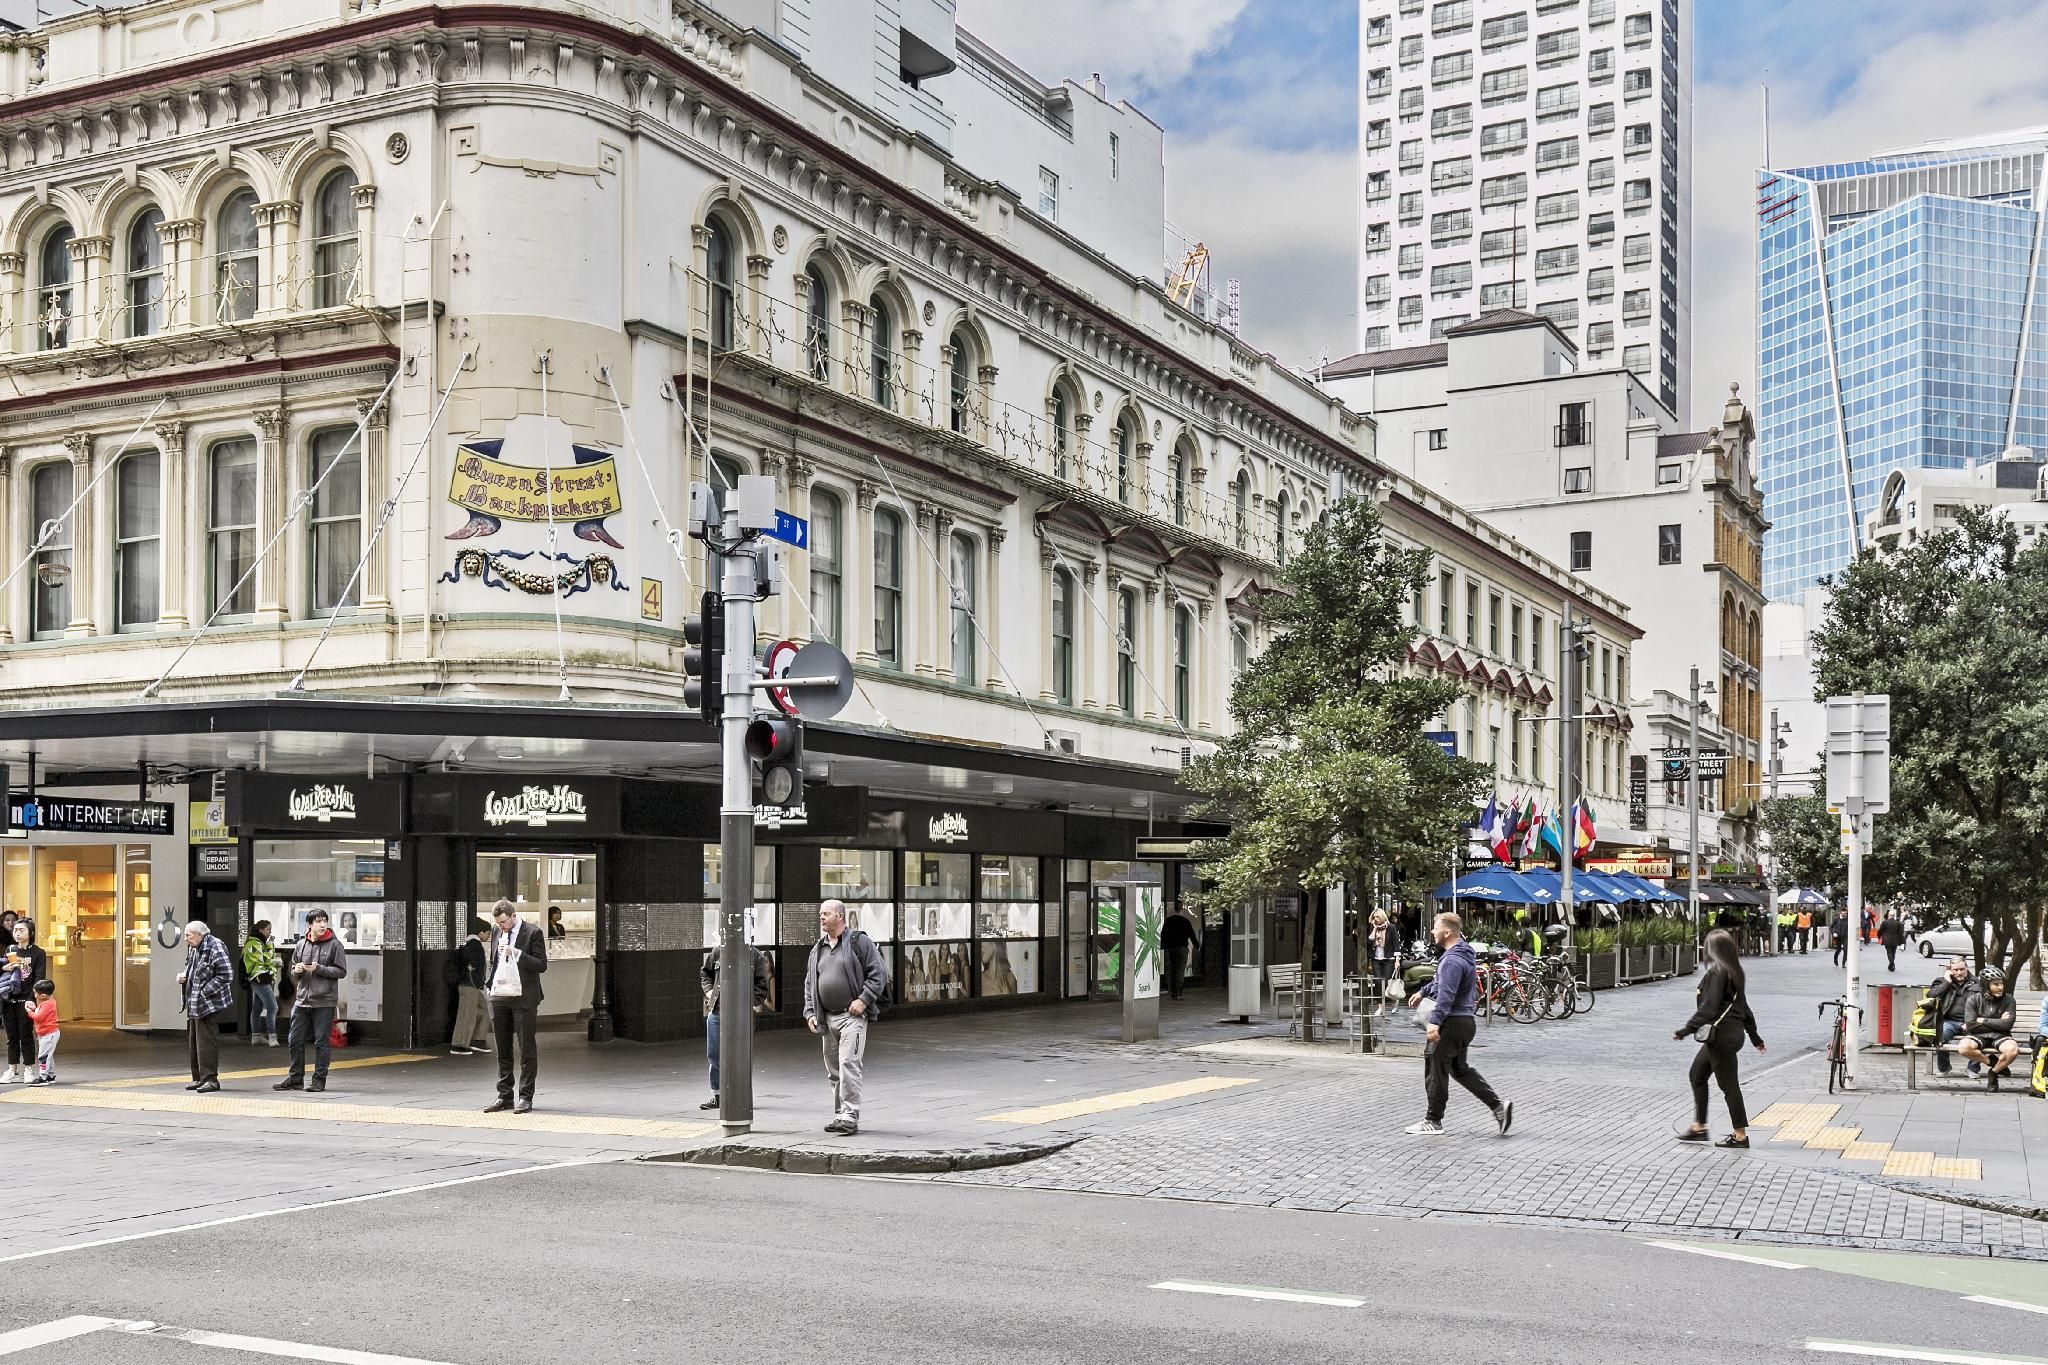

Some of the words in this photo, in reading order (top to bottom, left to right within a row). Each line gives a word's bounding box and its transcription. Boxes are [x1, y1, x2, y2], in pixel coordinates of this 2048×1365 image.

[458, 457, 533, 493] Queen
[458, 484, 612, 521] Backpackers
[644, 583, 660, 610] 4
[1698, 760, 1724, 768] TREET
[50, 803, 124, 824] INTERNET
[131, 808, 168, 827] CAFE
[191, 828, 220, 838] INTERNET
[1466, 860, 1491, 868] GAMING
[1099, 983, 1117, 992] Spark
[1138, 983, 1151, 994] Spark
